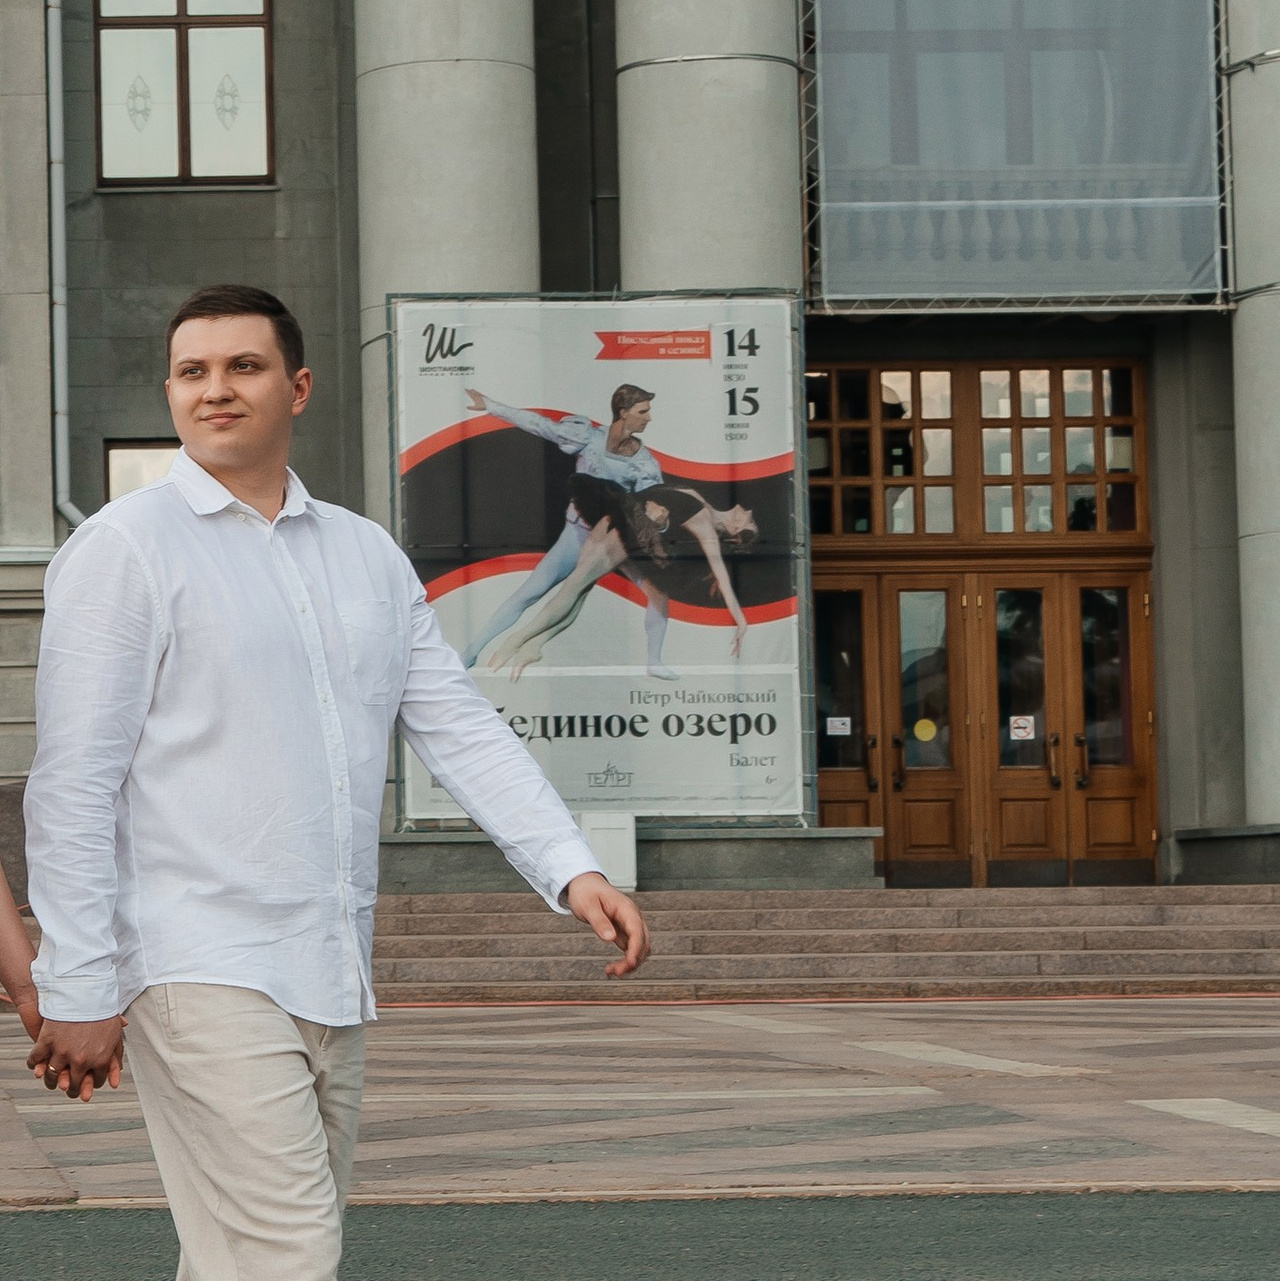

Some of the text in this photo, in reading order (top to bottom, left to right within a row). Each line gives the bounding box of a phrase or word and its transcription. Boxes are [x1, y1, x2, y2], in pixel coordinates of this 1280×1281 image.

[723, 328, 760, 357] 14
[724, 387, 760, 416] 15
[629, 688, 777, 707] Пётр Чайковский
[495, 706, 777, 745] единое озеро
[729, 753, 777, 767] Балет
